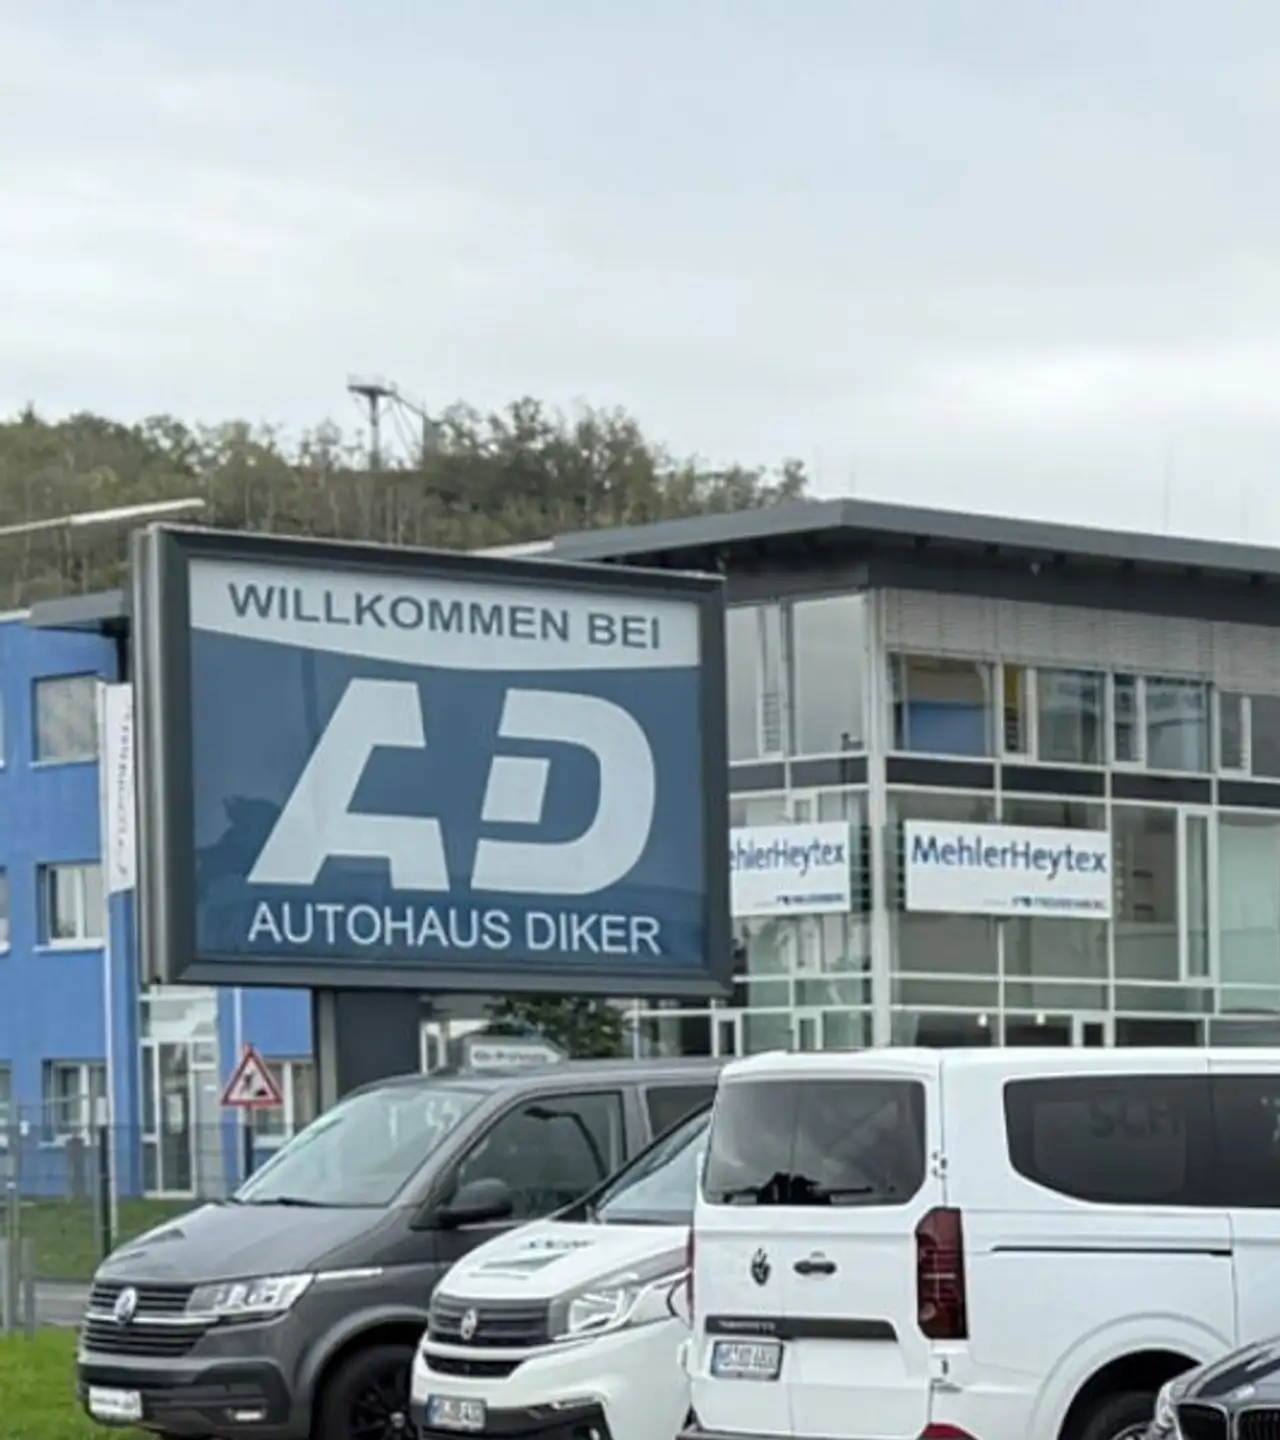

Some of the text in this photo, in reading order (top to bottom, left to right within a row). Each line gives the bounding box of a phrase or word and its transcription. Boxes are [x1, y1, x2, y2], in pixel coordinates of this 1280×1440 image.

[228, 582, 661, 650] WILLKOMMEN BEI
[247, 677, 656, 895] AD
[731, 836, 845, 878] ehlerHeytex
[911, 834, 1108, 881] MehlerHeytex
[248, 902, 662, 956] AUTOHAUS DIKER
